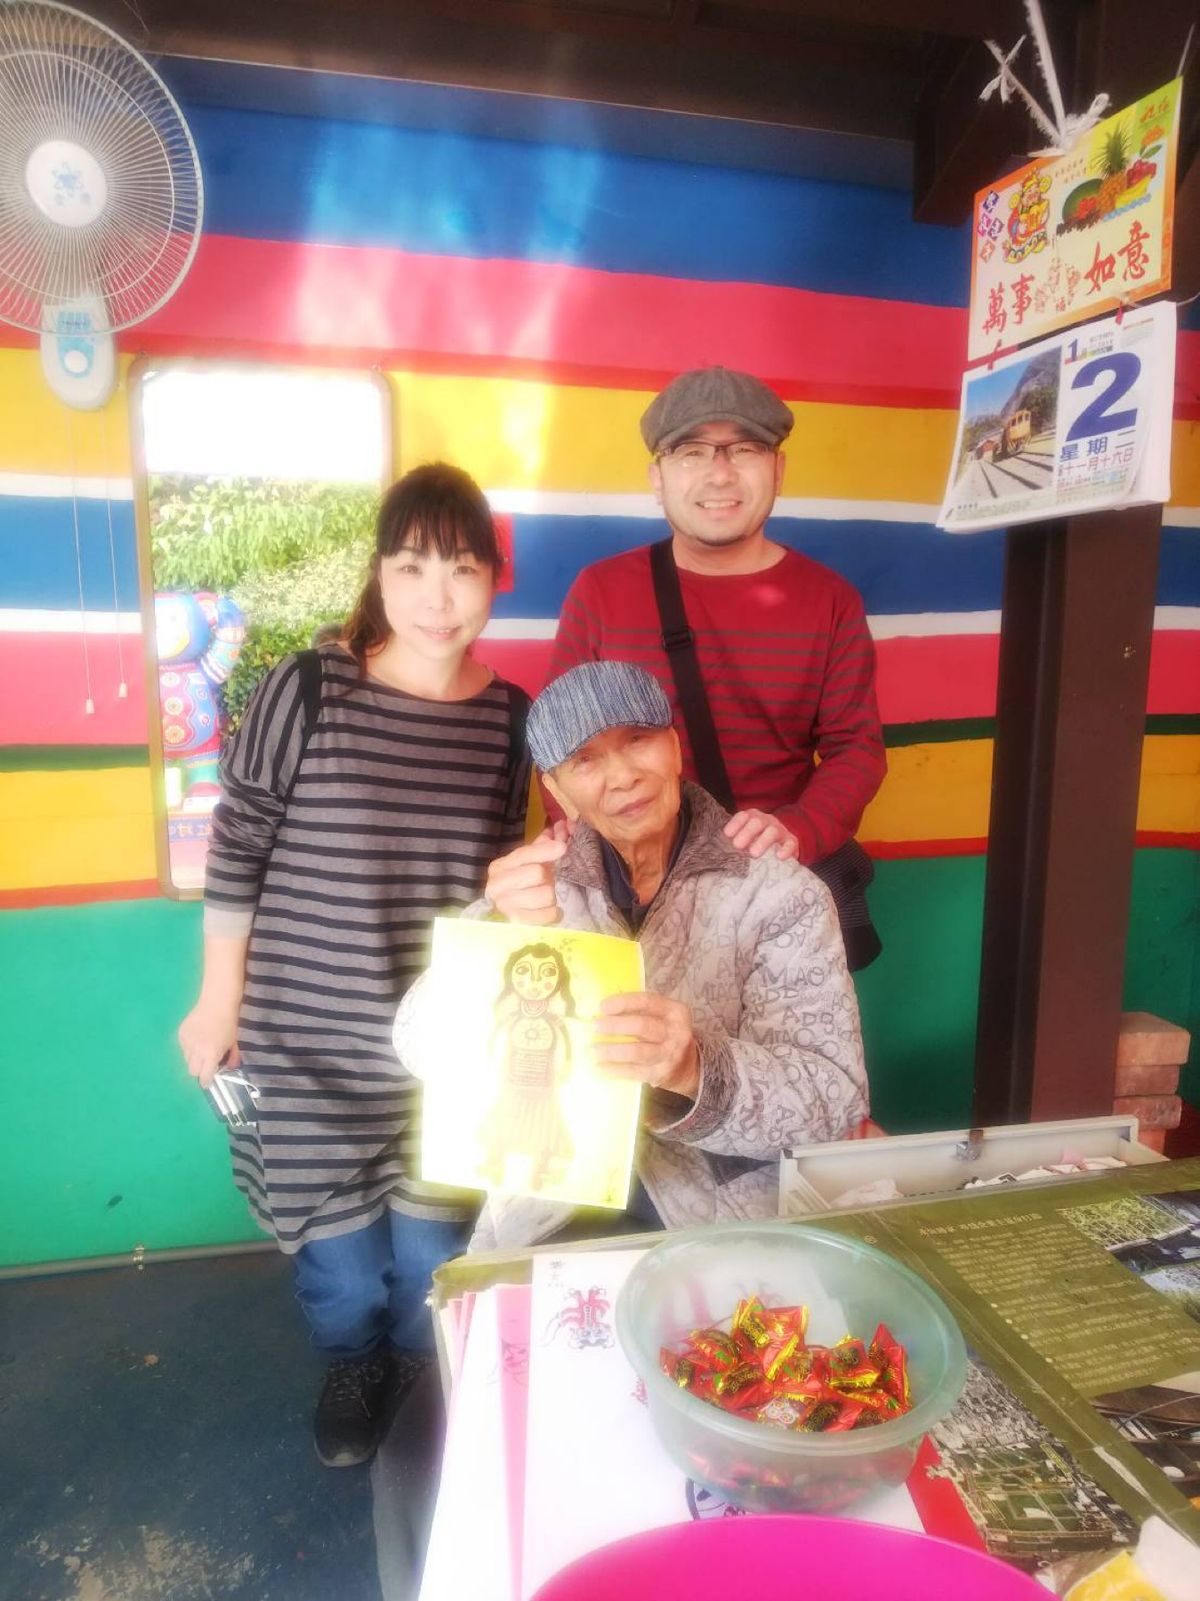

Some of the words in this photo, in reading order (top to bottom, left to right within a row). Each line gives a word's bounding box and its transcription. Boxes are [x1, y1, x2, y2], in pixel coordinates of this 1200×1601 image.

[1084, 220, 1150, 295] 如意
[1065, 352, 1141, 441] 2
[1059, 429, 1136, 463] 星期二
